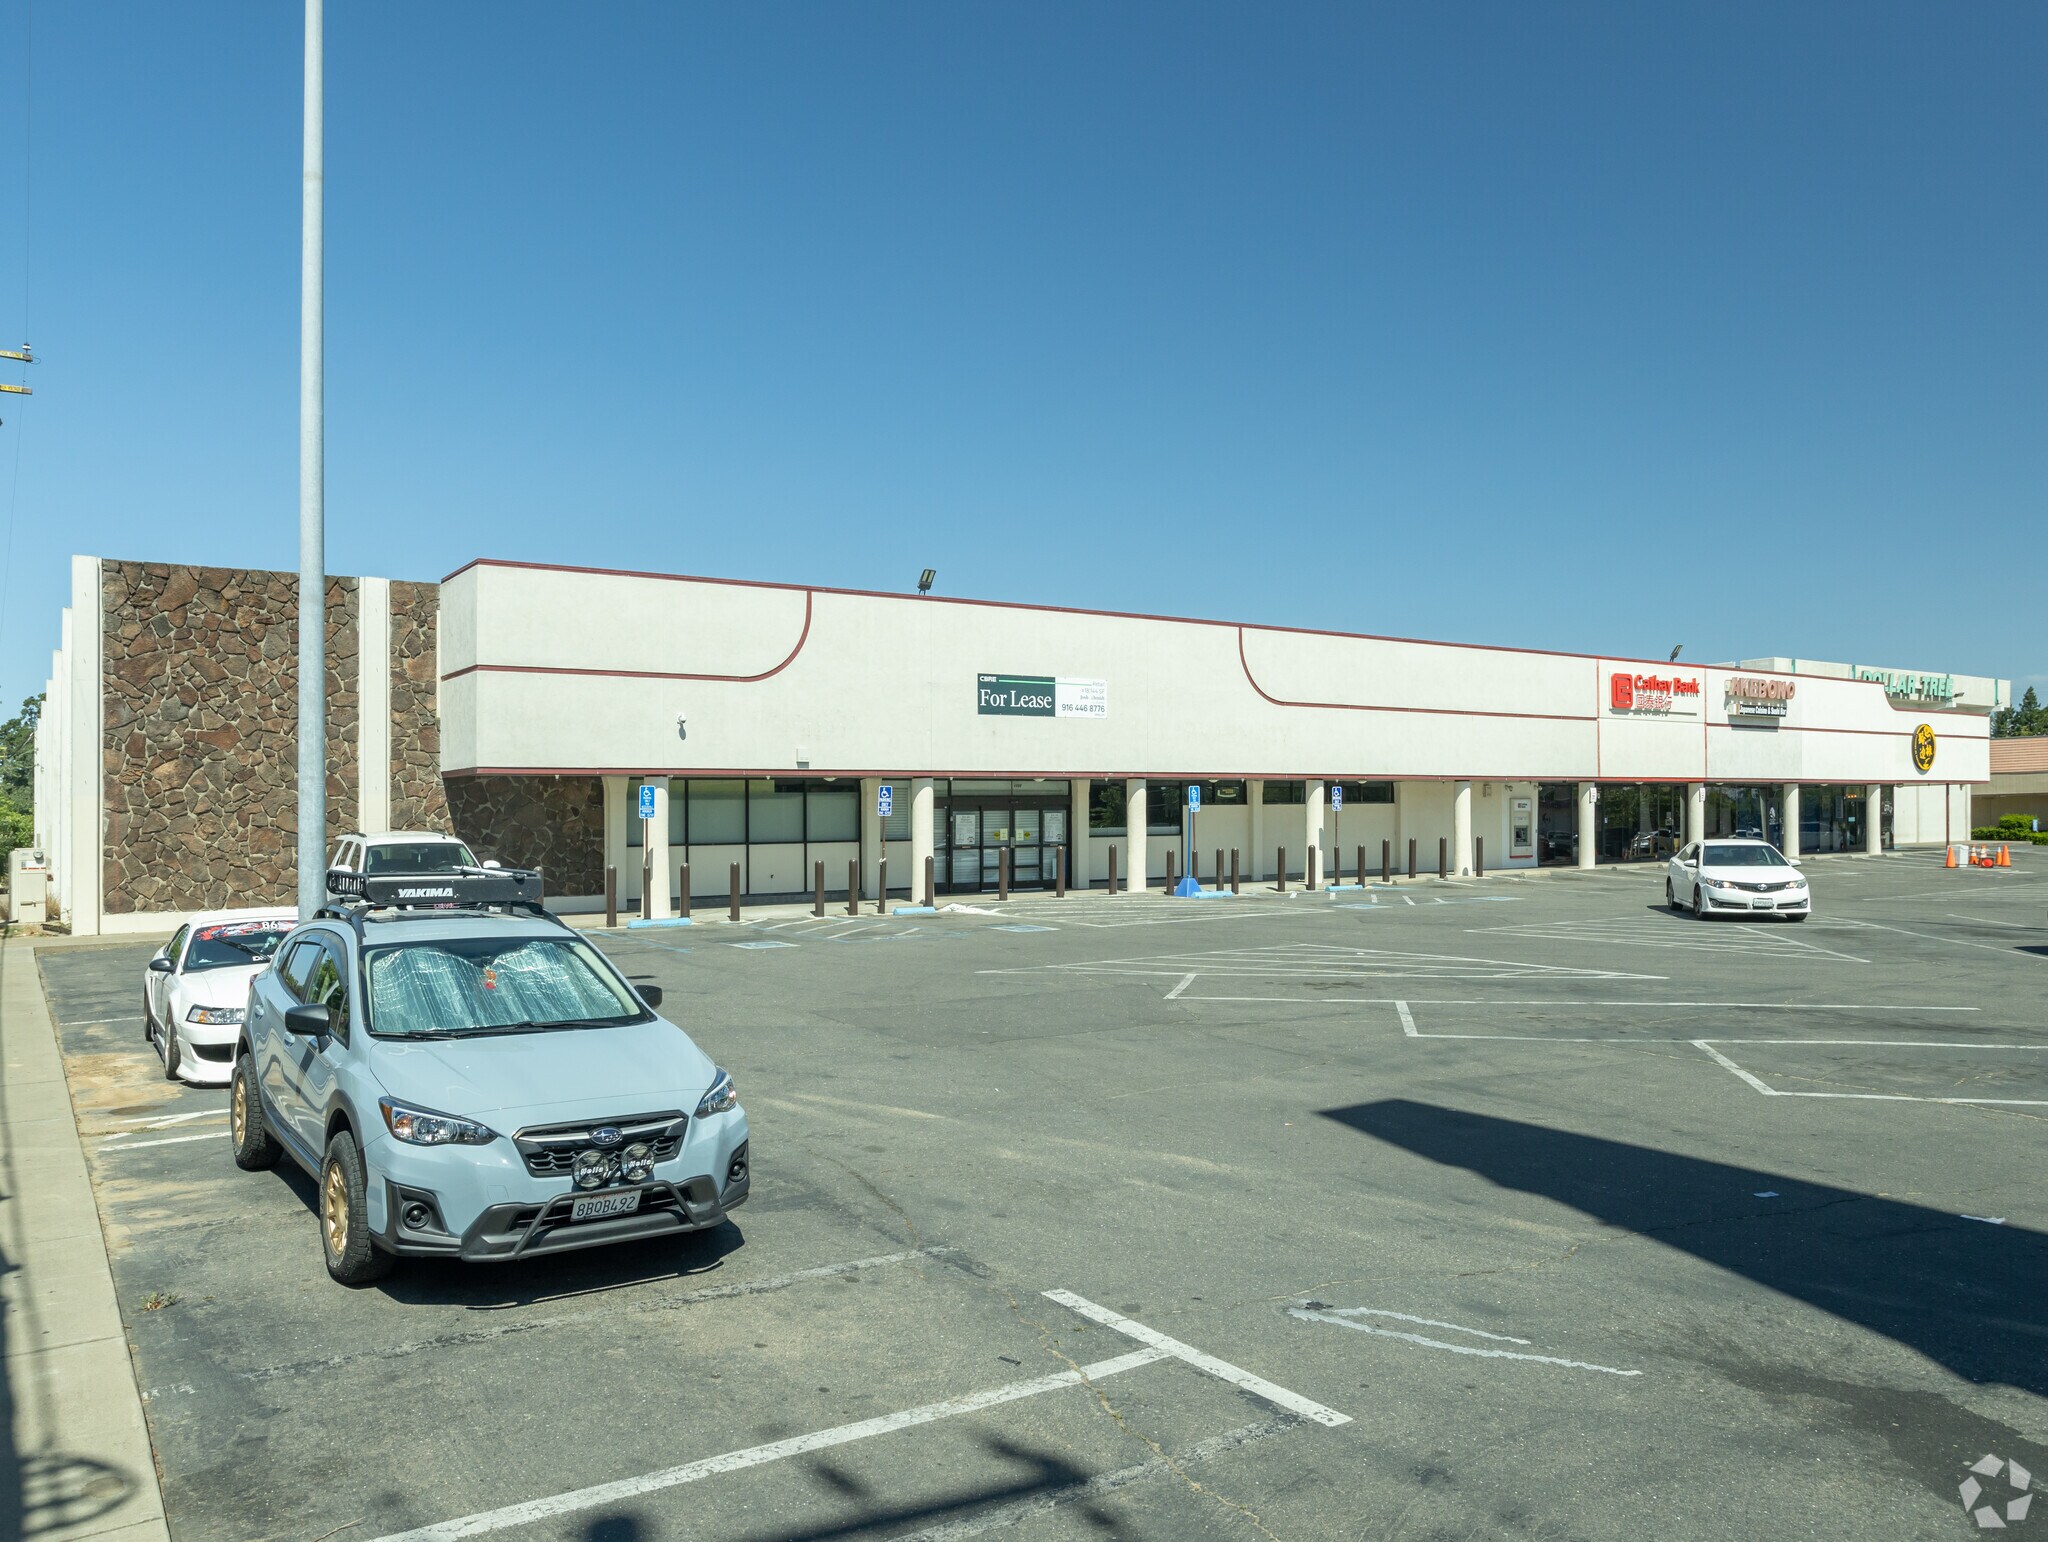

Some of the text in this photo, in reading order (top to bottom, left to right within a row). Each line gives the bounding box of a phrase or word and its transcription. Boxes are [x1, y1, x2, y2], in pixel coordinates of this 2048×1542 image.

[1634, 674, 1700, 695] Cathay Bank
[1728, 677, 1796, 700] AKEBONO
[1920, 676, 1953, 697] TREE
[980, 689, 1052, 709] For Lease
[1061, 703, 1105, 712] 916 446 8776
[398, 888, 453, 898] YAKIMA
[576, 1196, 636, 1217] 8BQB492
